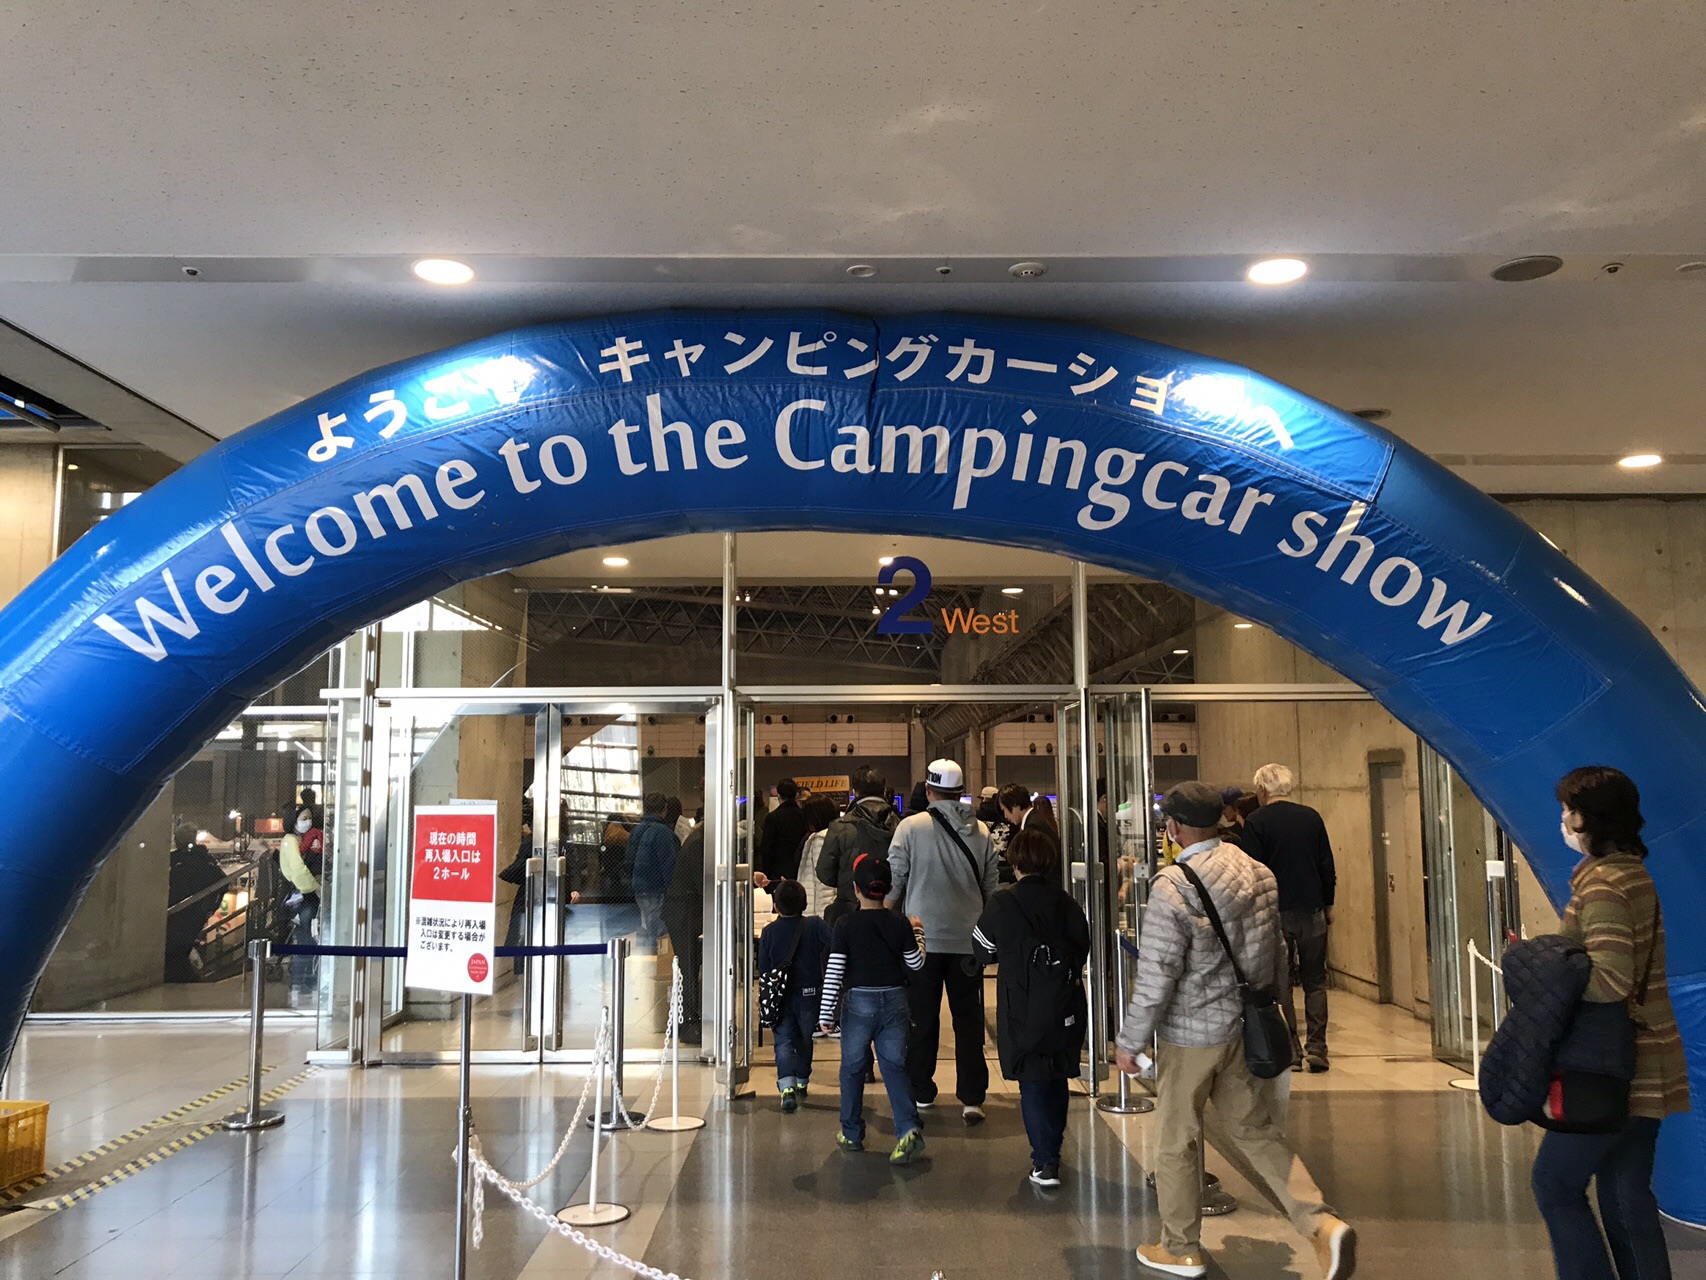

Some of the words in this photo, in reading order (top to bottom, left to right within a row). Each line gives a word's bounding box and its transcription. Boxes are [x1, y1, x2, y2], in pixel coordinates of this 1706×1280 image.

[92, 459, 486, 662] Welcome
[498, 435, 588, 494] to
[608, 392, 749, 476] the
[774, 398, 1276, 535] Campingcar
[1276, 500, 1493, 646] show
[877, 556, 934, 634] 2
[941, 607, 1020, 634] West
[824, 779, 847, 788] LIFE
[429, 831, 477, 847] 現在の時間
[425, 848, 481, 863] 再入場入口は
